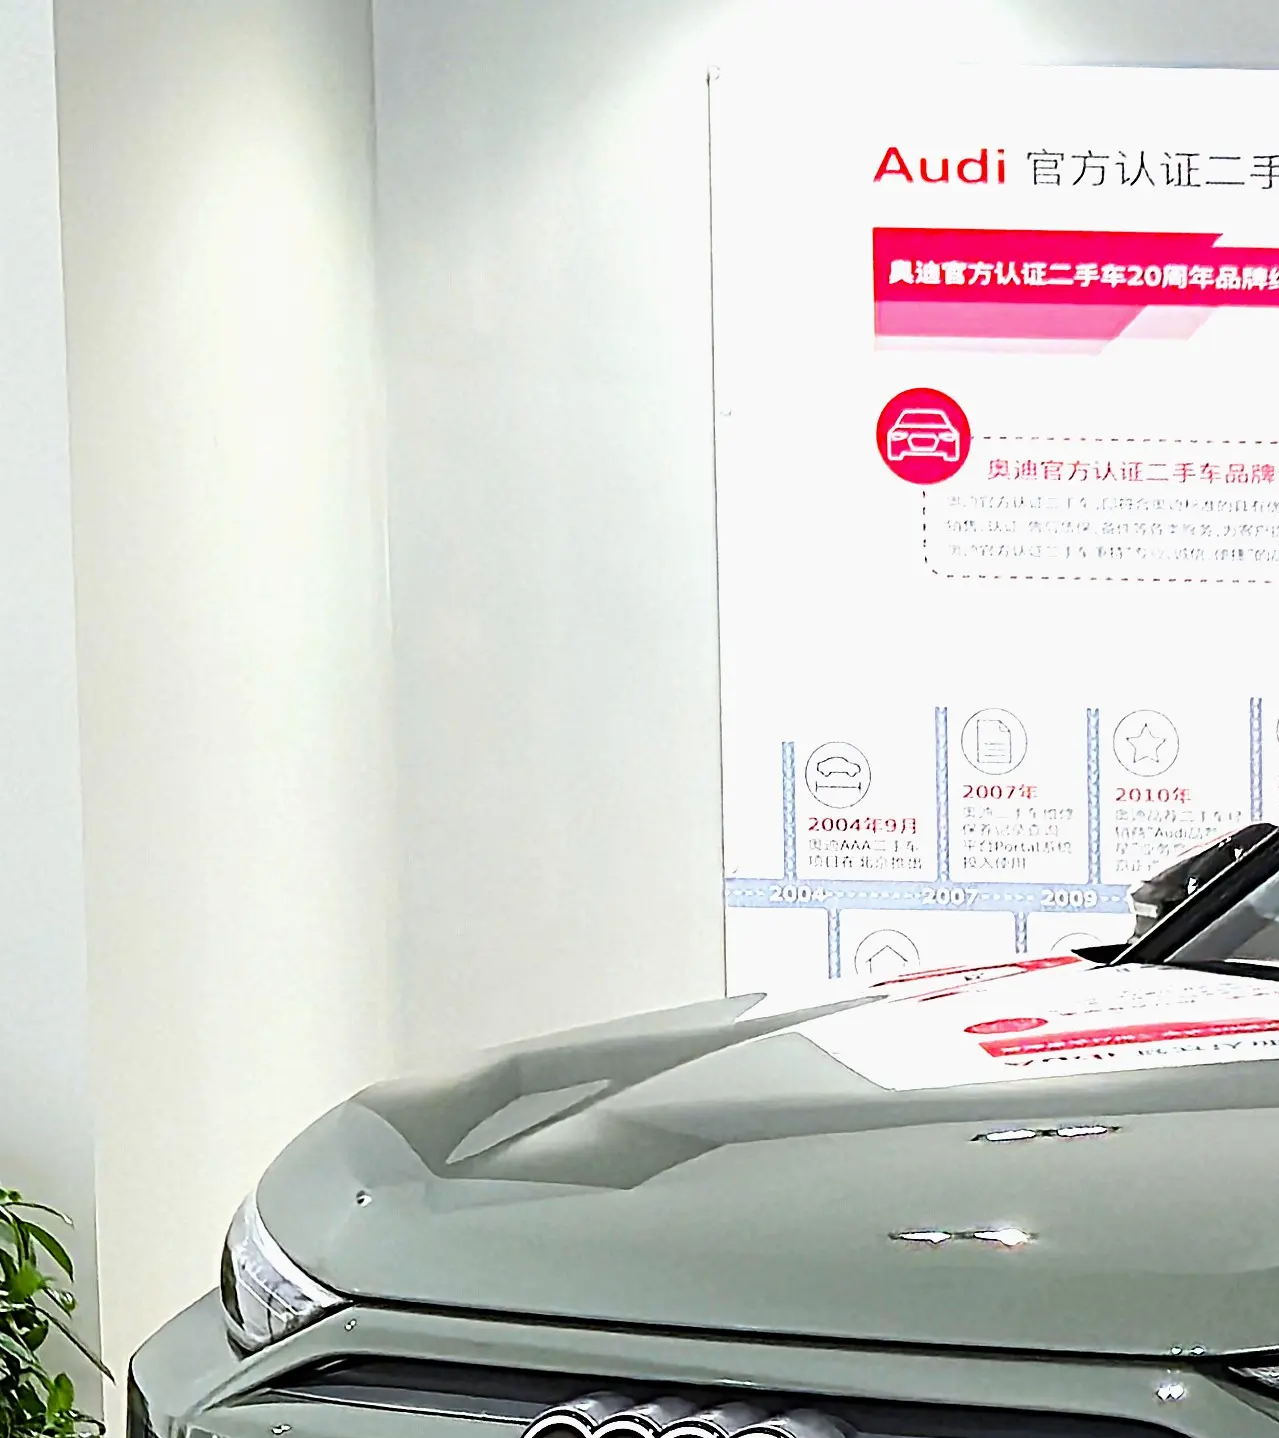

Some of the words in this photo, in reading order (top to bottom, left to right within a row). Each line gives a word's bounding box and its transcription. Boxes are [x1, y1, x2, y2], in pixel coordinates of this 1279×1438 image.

[873, 145, 1006, 185] Audi
[962, 783, 1038, 800] 2007年
[1114, 786, 1192, 803] 2010年
[807, 816, 918, 835] 2004年9月
[768, 885, 827, 903] 2004
[921, 887, 979, 905] 2007
[1040, 889, 1098, 908] 2009
